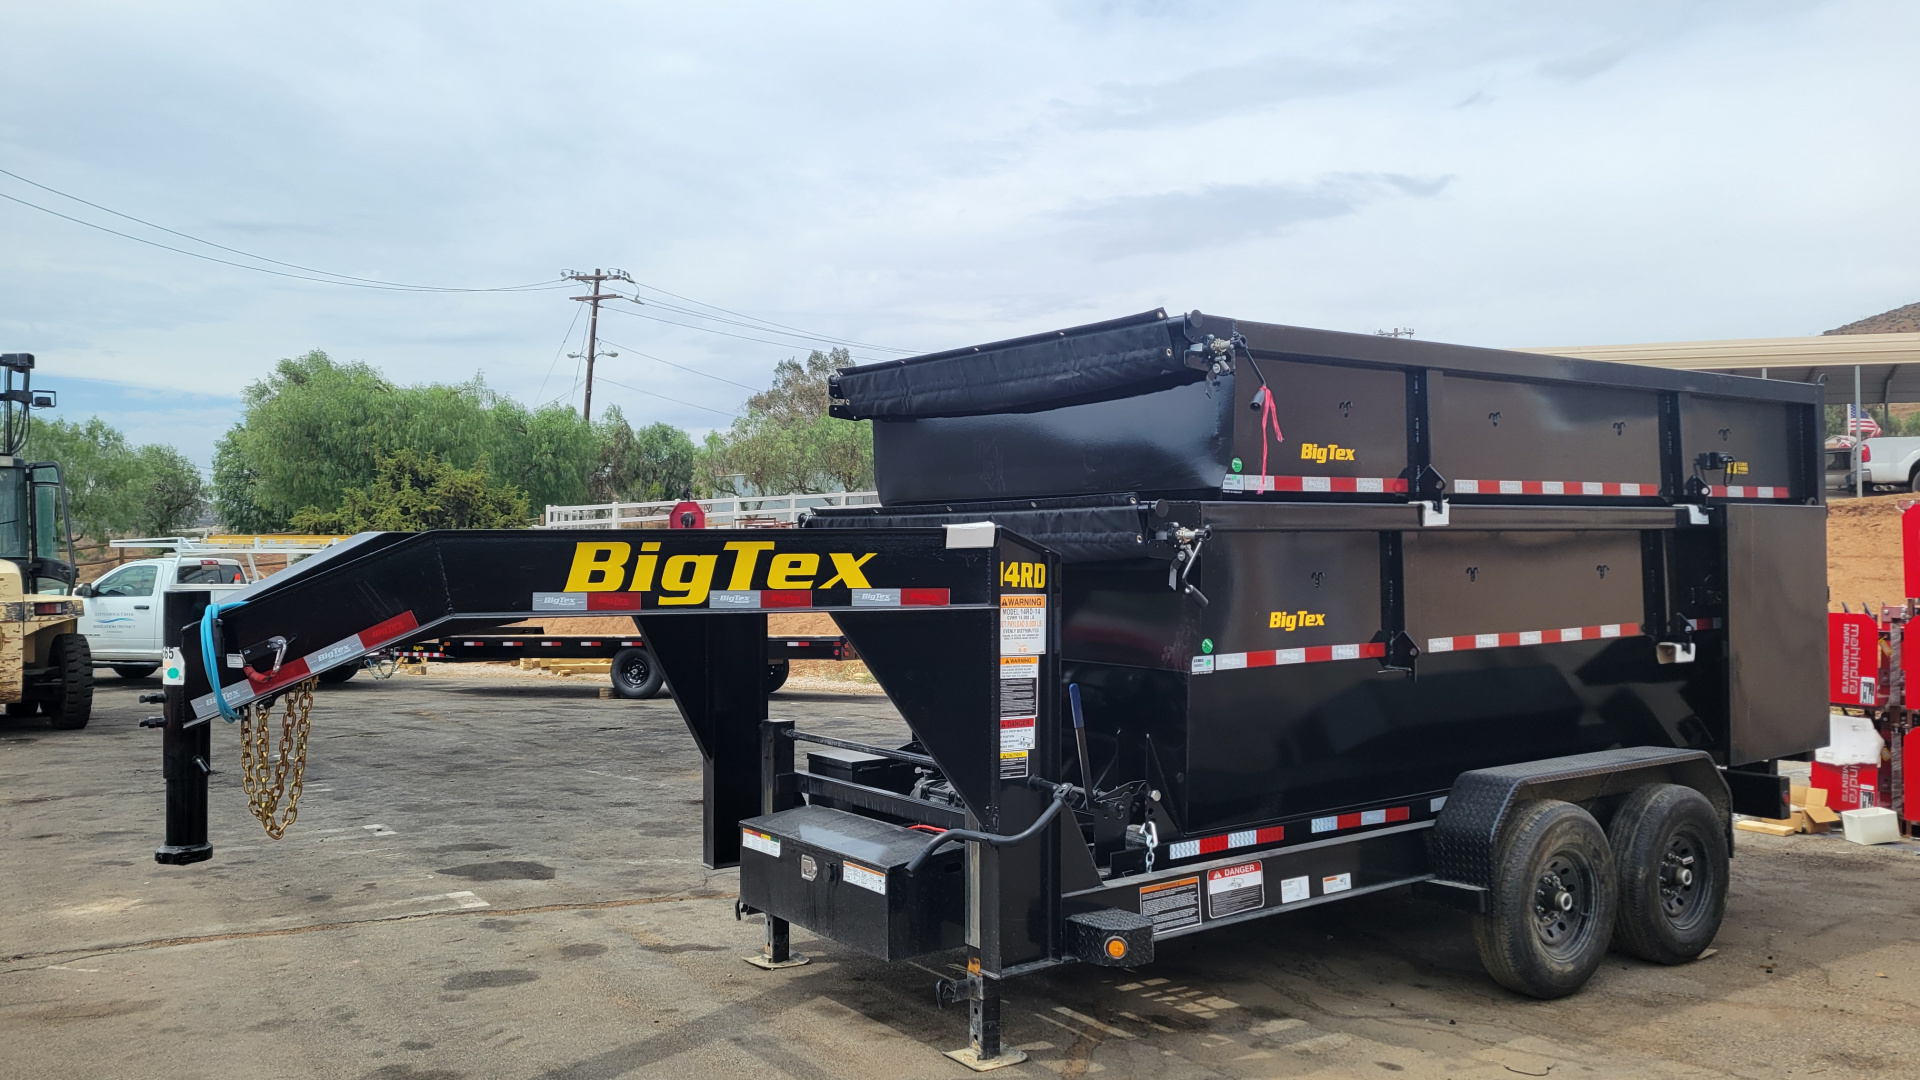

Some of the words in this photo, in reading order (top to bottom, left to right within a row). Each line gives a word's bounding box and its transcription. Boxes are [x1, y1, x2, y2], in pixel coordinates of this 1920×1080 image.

[563, 541, 878, 605] BigTex
[1008, 597, 1042, 606] WARNING
[317, 644, 352, 662] BigTex
[1842, 624, 1850, 694] IMPLEMENTS
[1849, 624, 1861, 694] mahindra
[1007, 720, 1028, 728] DANGER
[1224, 864, 1255, 877] DANGER
